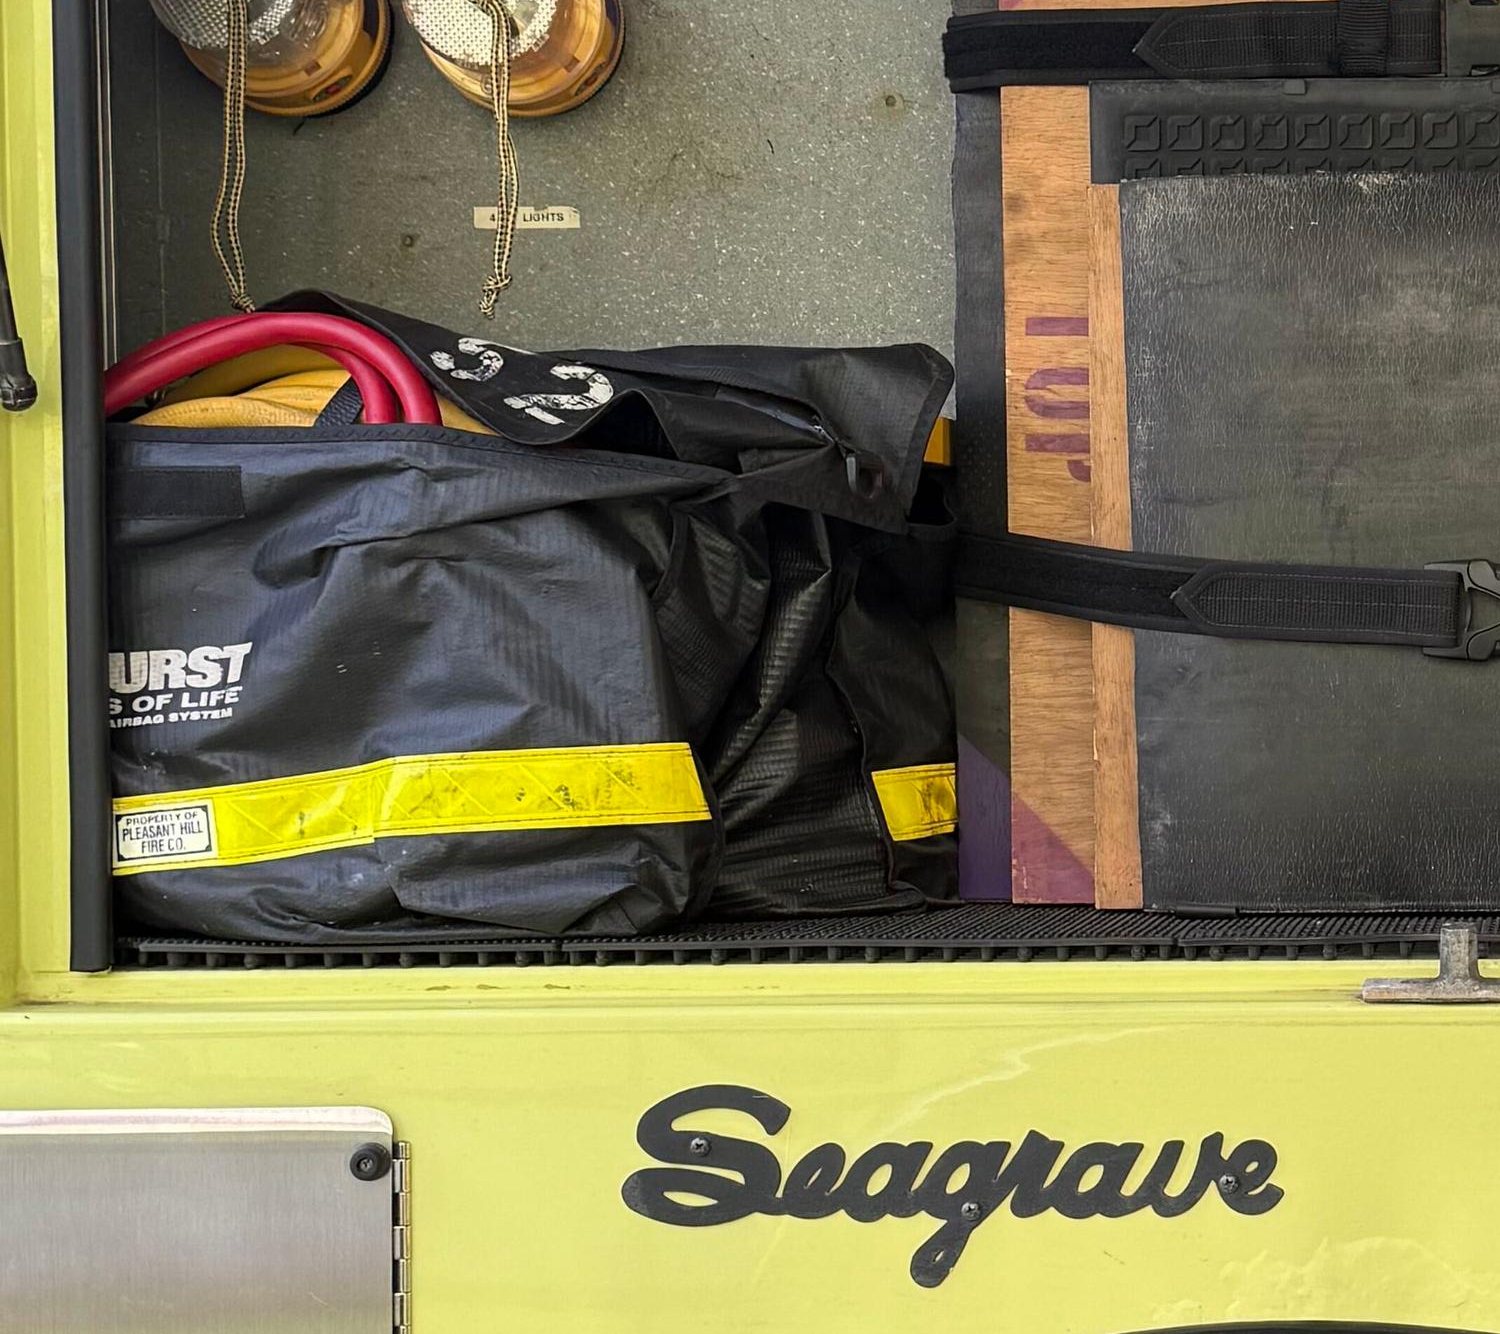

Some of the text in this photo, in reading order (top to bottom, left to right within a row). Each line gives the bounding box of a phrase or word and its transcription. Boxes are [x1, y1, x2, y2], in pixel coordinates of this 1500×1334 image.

[522, 213, 565, 223] LIGHTS
[131, 693, 174, 713] OF
[180, 685, 243, 708] LIFE
[167, 707, 233, 723] SYSTEM
[126, 811, 199, 826] PROPERTY OF
[122, 821, 204, 842] PLEASANT HILL
[141, 837, 187, 854] FIRE CO.
[621, 1083, 1284, 1289] Seagrave
